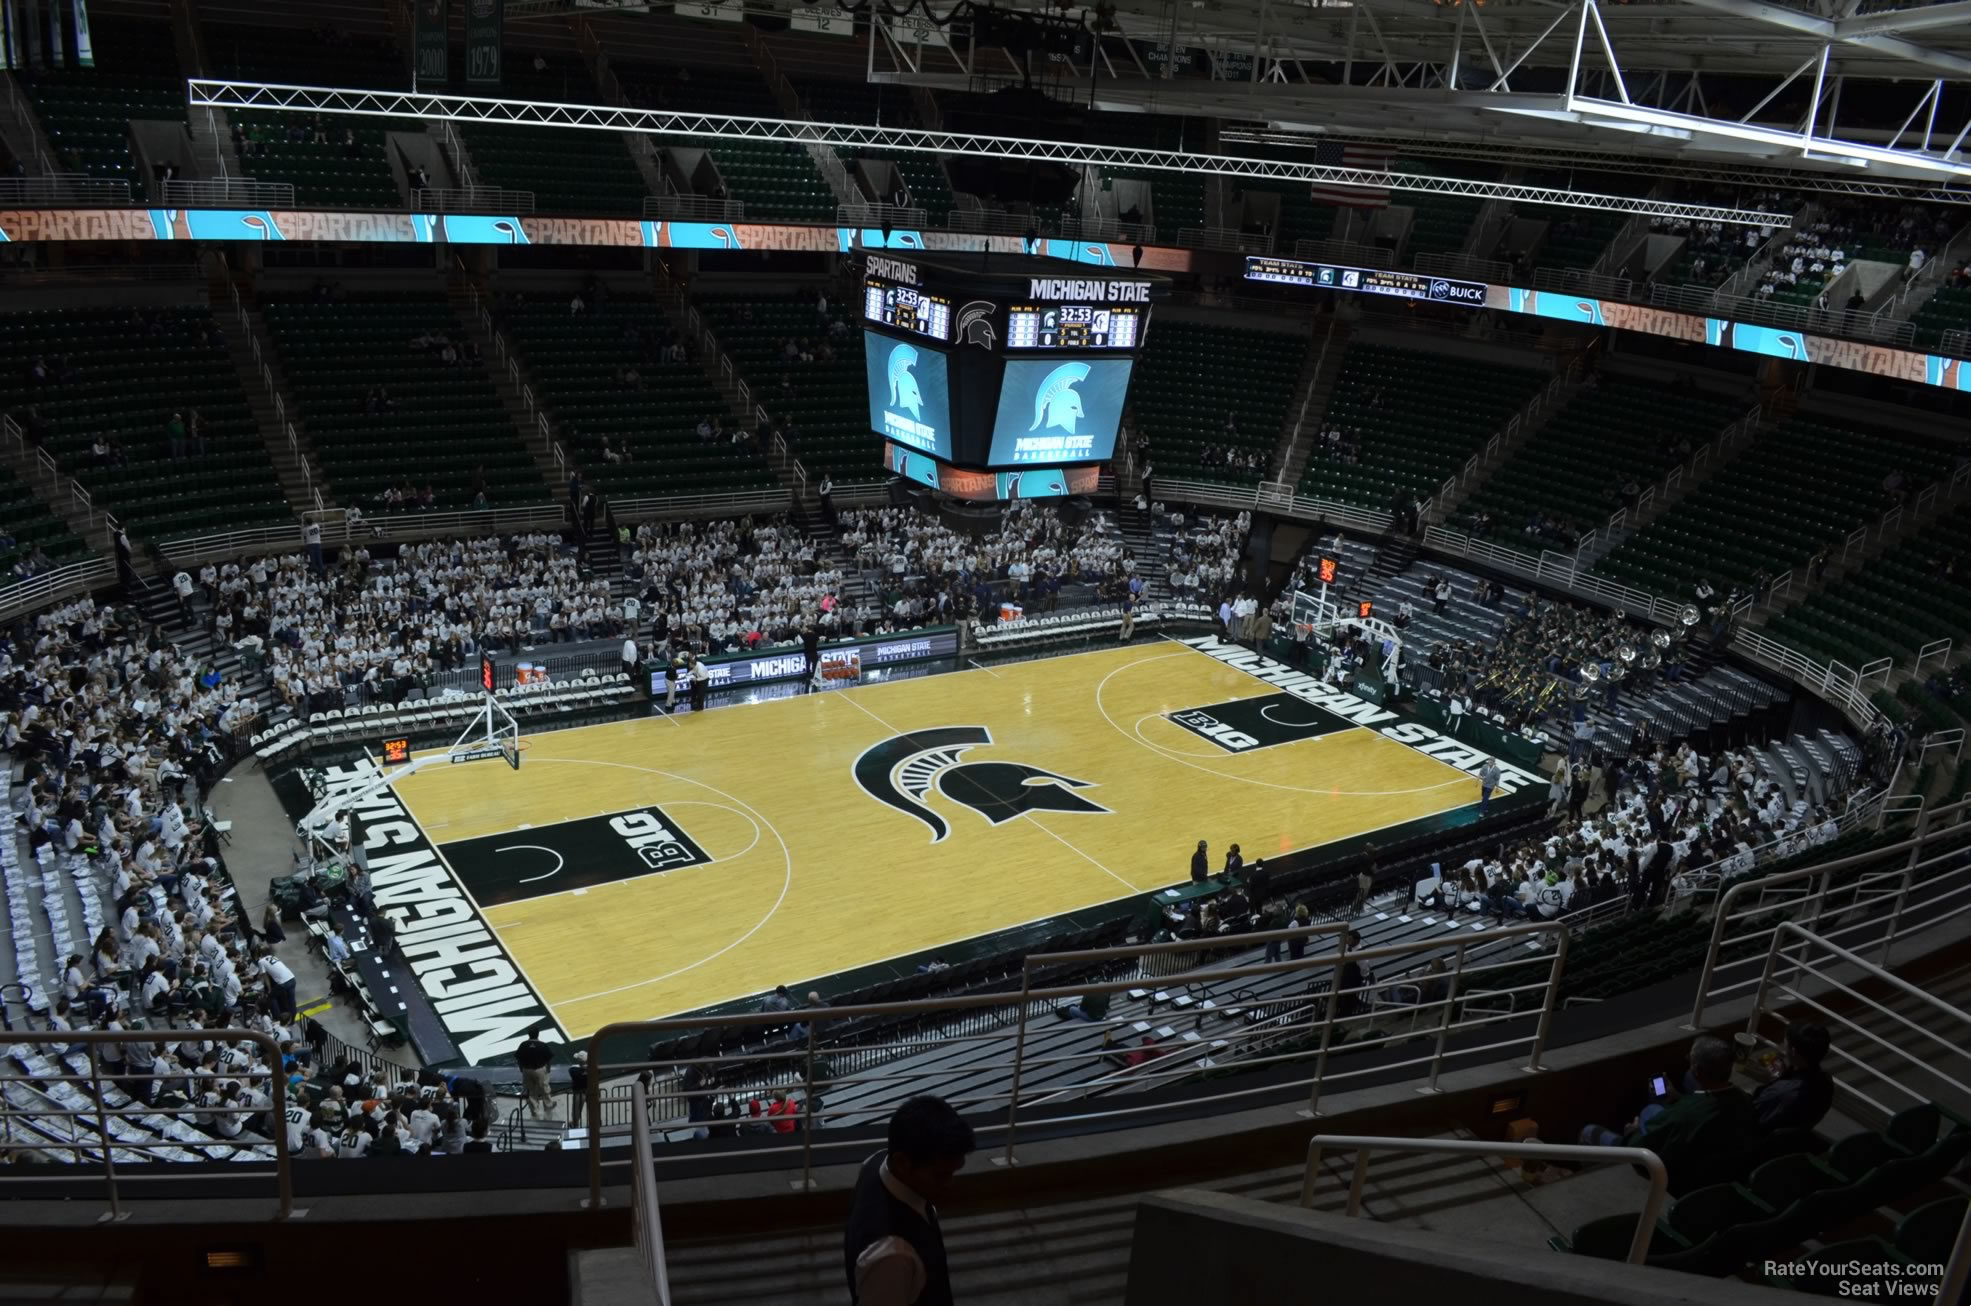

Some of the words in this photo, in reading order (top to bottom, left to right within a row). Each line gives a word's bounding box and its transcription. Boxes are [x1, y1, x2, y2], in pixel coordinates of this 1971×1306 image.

[816, 18, 831, 31] 12
[420, 48, 444, 76] 2000
[470, 46, 498, 76] 1979
[3, 211, 150, 241] SPARTANS
[277, 213, 414, 242] SPARTANS
[522, 219, 641, 246] SPARTANS
[735, 225, 838, 252] SPARTANS
[866, 255, 917, 285] SPARTANS
[896, 288, 918, 307] 32:53
[1029, 279, 1106, 301] MICHIGAN
[1107, 282, 1151, 302] STATE
[1449, 286, 1483, 300] BUICK
[1060, 308, 1091, 321] 32:53
[1601, 300, 1706, 344] SPARTANS
[1044, 333, 1052, 346] 0
[1095, 333, 1103, 346] 0
[1804, 333, 1927, 384] SPARTANS
[877, 643, 911, 656] MICHIGAN
[911, 640, 932, 652] STATE
[1180, 635, 1401, 725] MICHIGAN
[1381, 722, 1551, 794] STATE
[366, 846, 567, 1068] MICHIGAN
[286, 1109, 303, 1125] 20
[341, 1133, 359, 1149] 20
